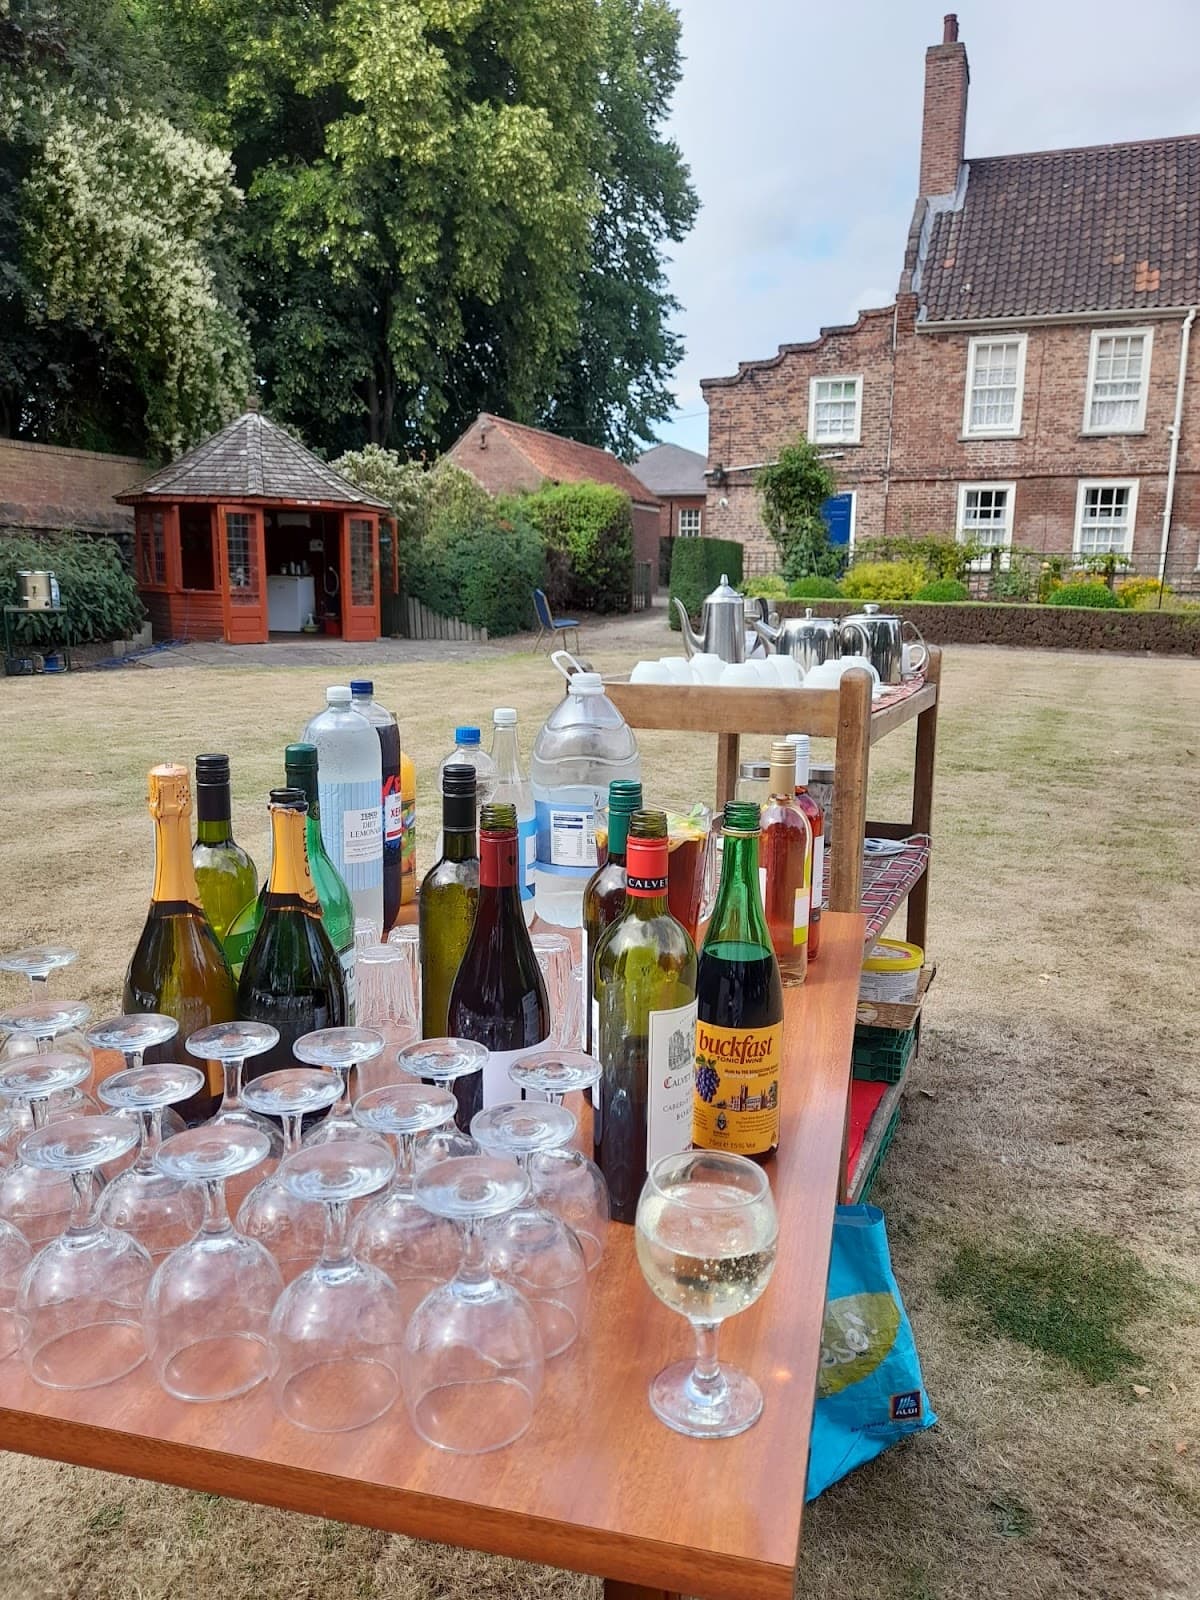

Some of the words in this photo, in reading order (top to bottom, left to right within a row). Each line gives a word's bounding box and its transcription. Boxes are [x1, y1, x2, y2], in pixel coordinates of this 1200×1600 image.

[699, 1029, 774, 1065] buckfast
[716, 1056, 740, 1064] TONIC
[895, 1407, 918, 1416] ALDI
